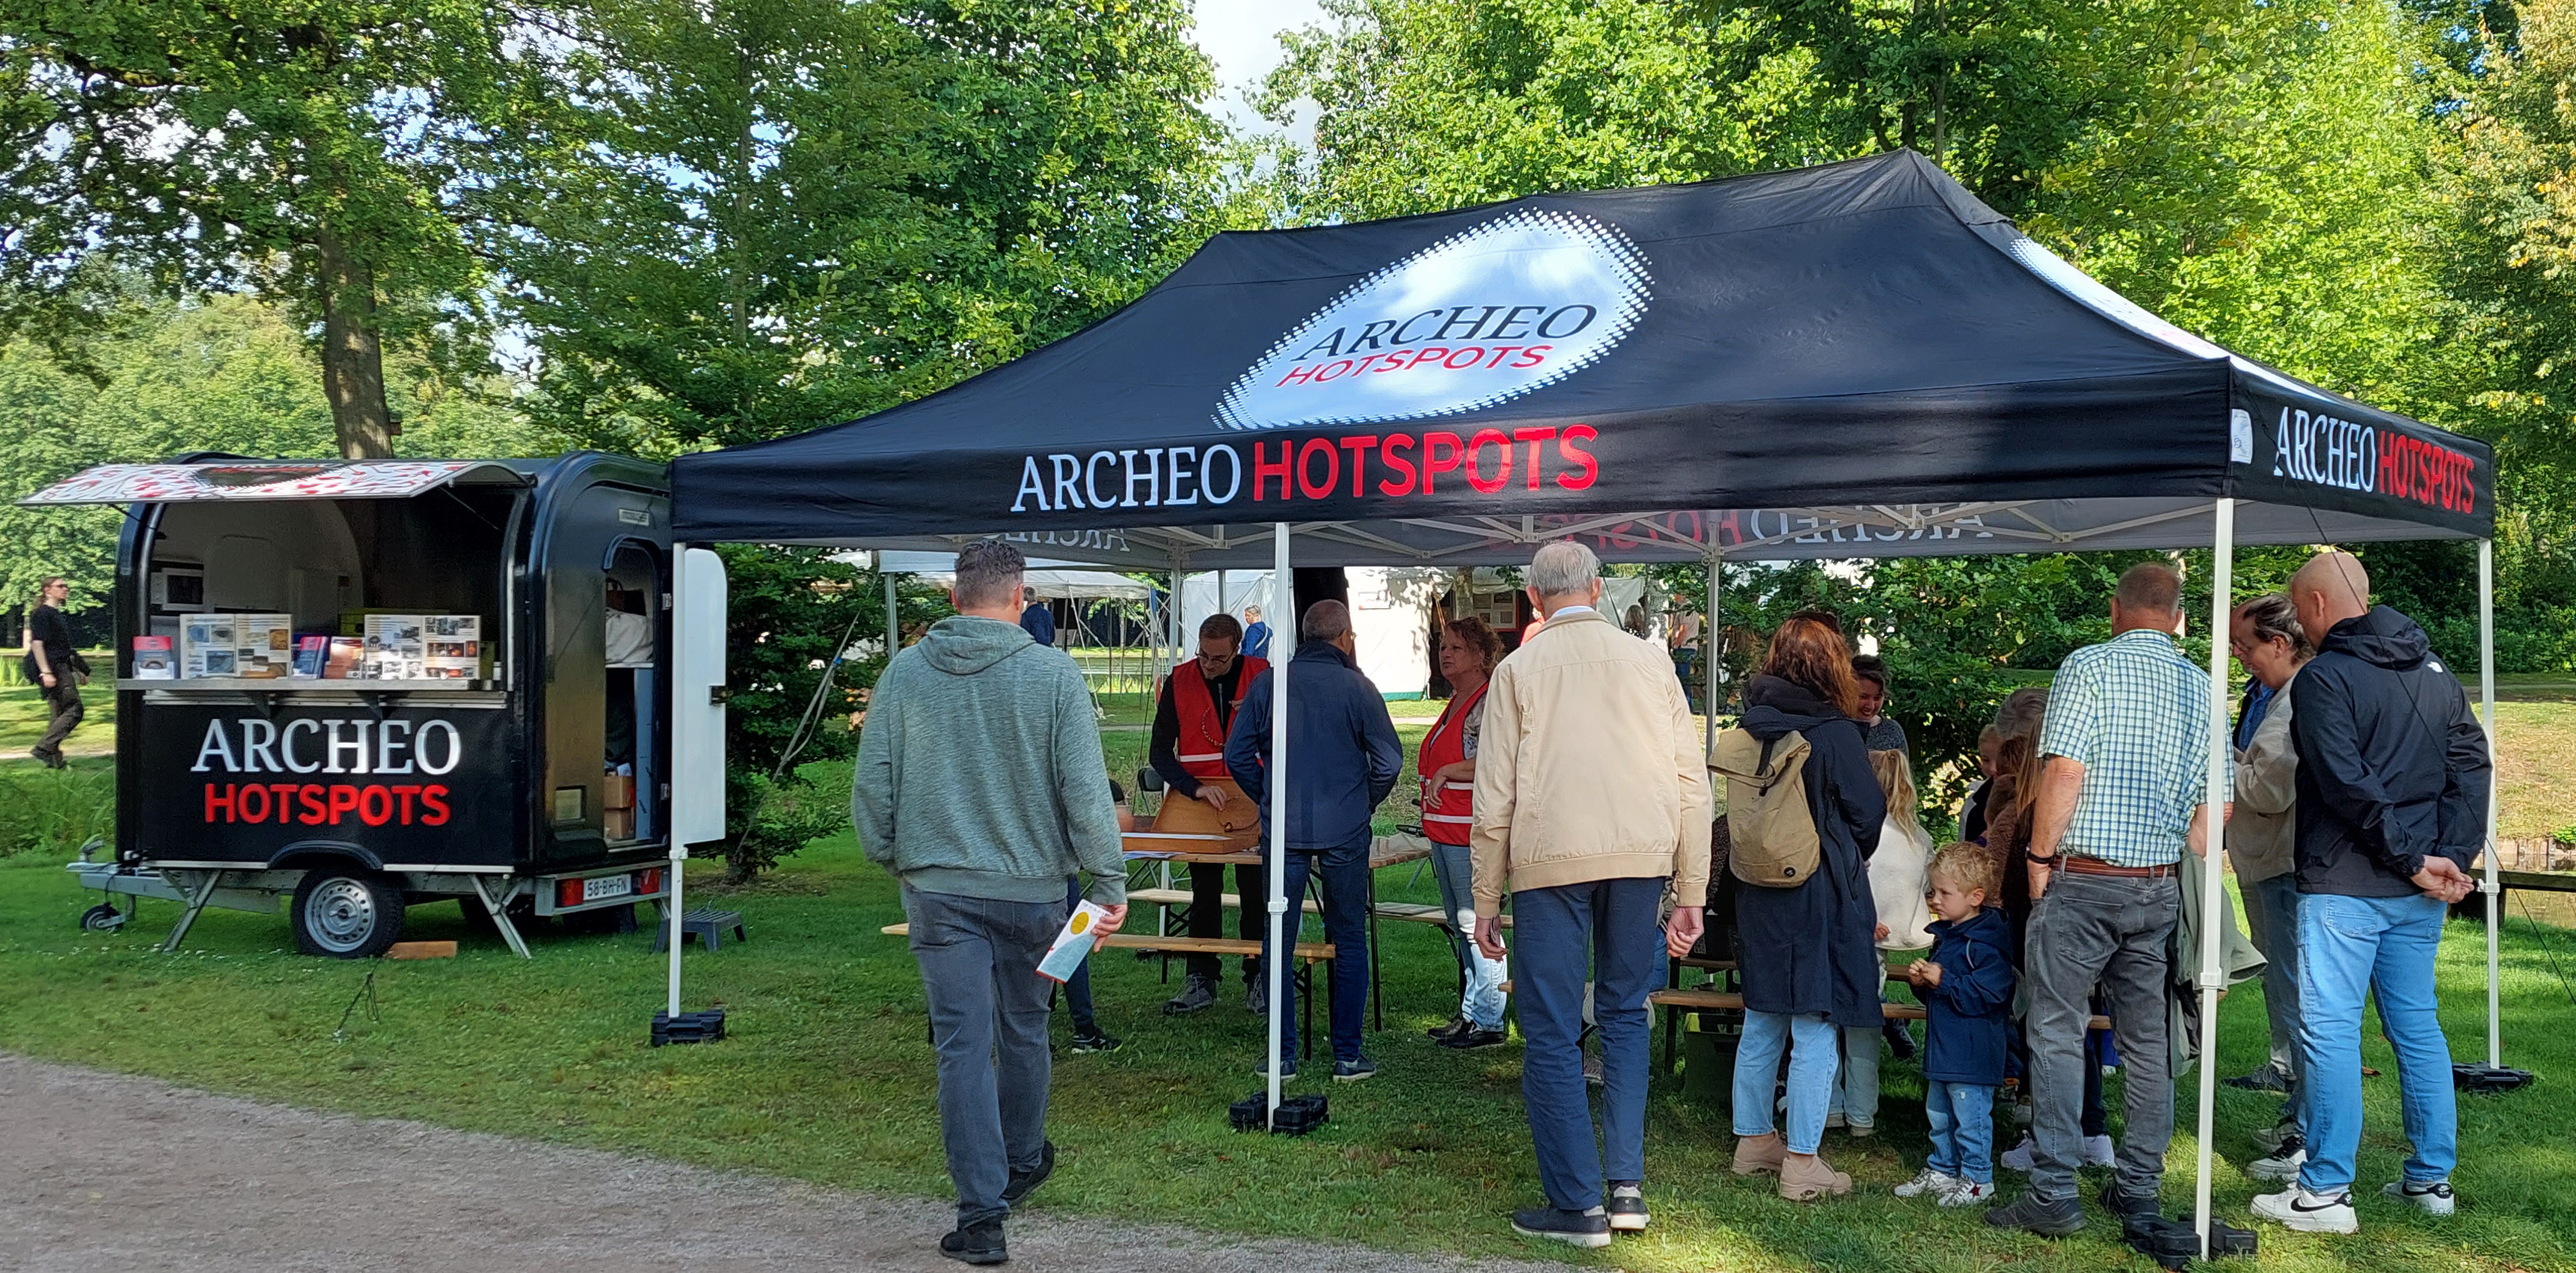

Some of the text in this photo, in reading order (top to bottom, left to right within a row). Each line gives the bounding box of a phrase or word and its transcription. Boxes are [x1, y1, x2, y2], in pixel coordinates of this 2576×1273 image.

[1290, 305, 1597, 362] ARCHEO
[1275, 345, 1555, 388] HOTSPOTS
[1009, 423, 1599, 513] ARCHEO HOTSPOTS
[2273, 407, 2376, 493] ARCHEO
[2378, 431, 2475, 514] HOTSPOTS
[190, 718, 461, 775] ARCHEO
[204, 783, 450, 826] HOTSPOTS
